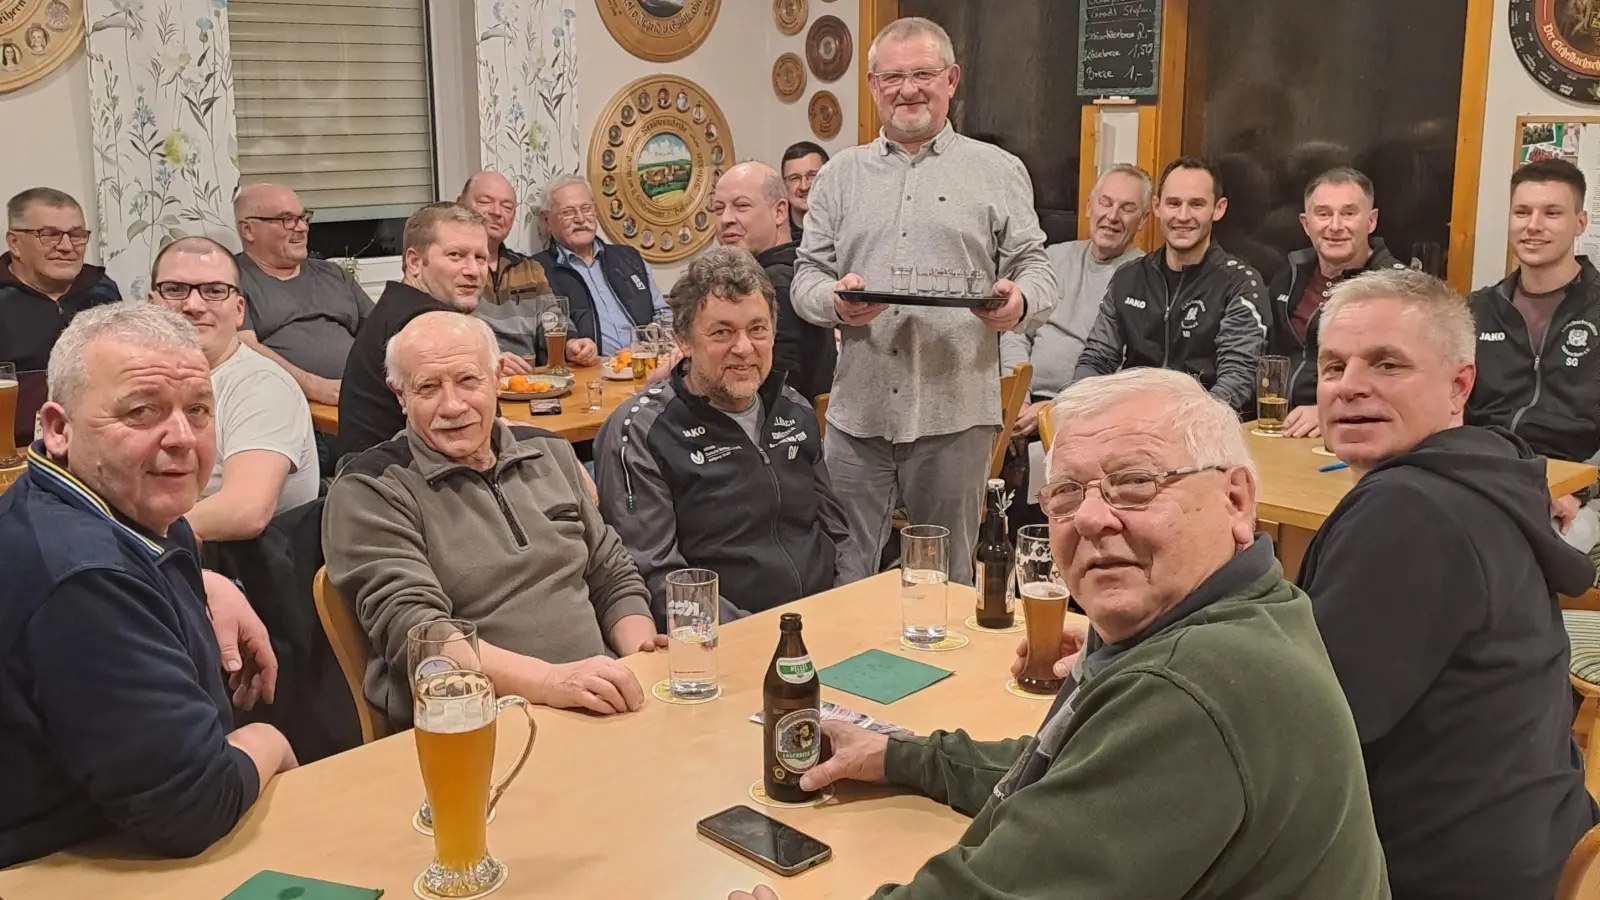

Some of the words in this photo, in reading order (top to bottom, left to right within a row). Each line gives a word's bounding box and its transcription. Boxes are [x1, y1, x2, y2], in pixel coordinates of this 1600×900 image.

[1085, 66, 1115, 80] Breze
[1124, 297, 1147, 309] JAKO
[1479, 331, 1506, 341] JAKO
[1565, 357, 1579, 367] SG
